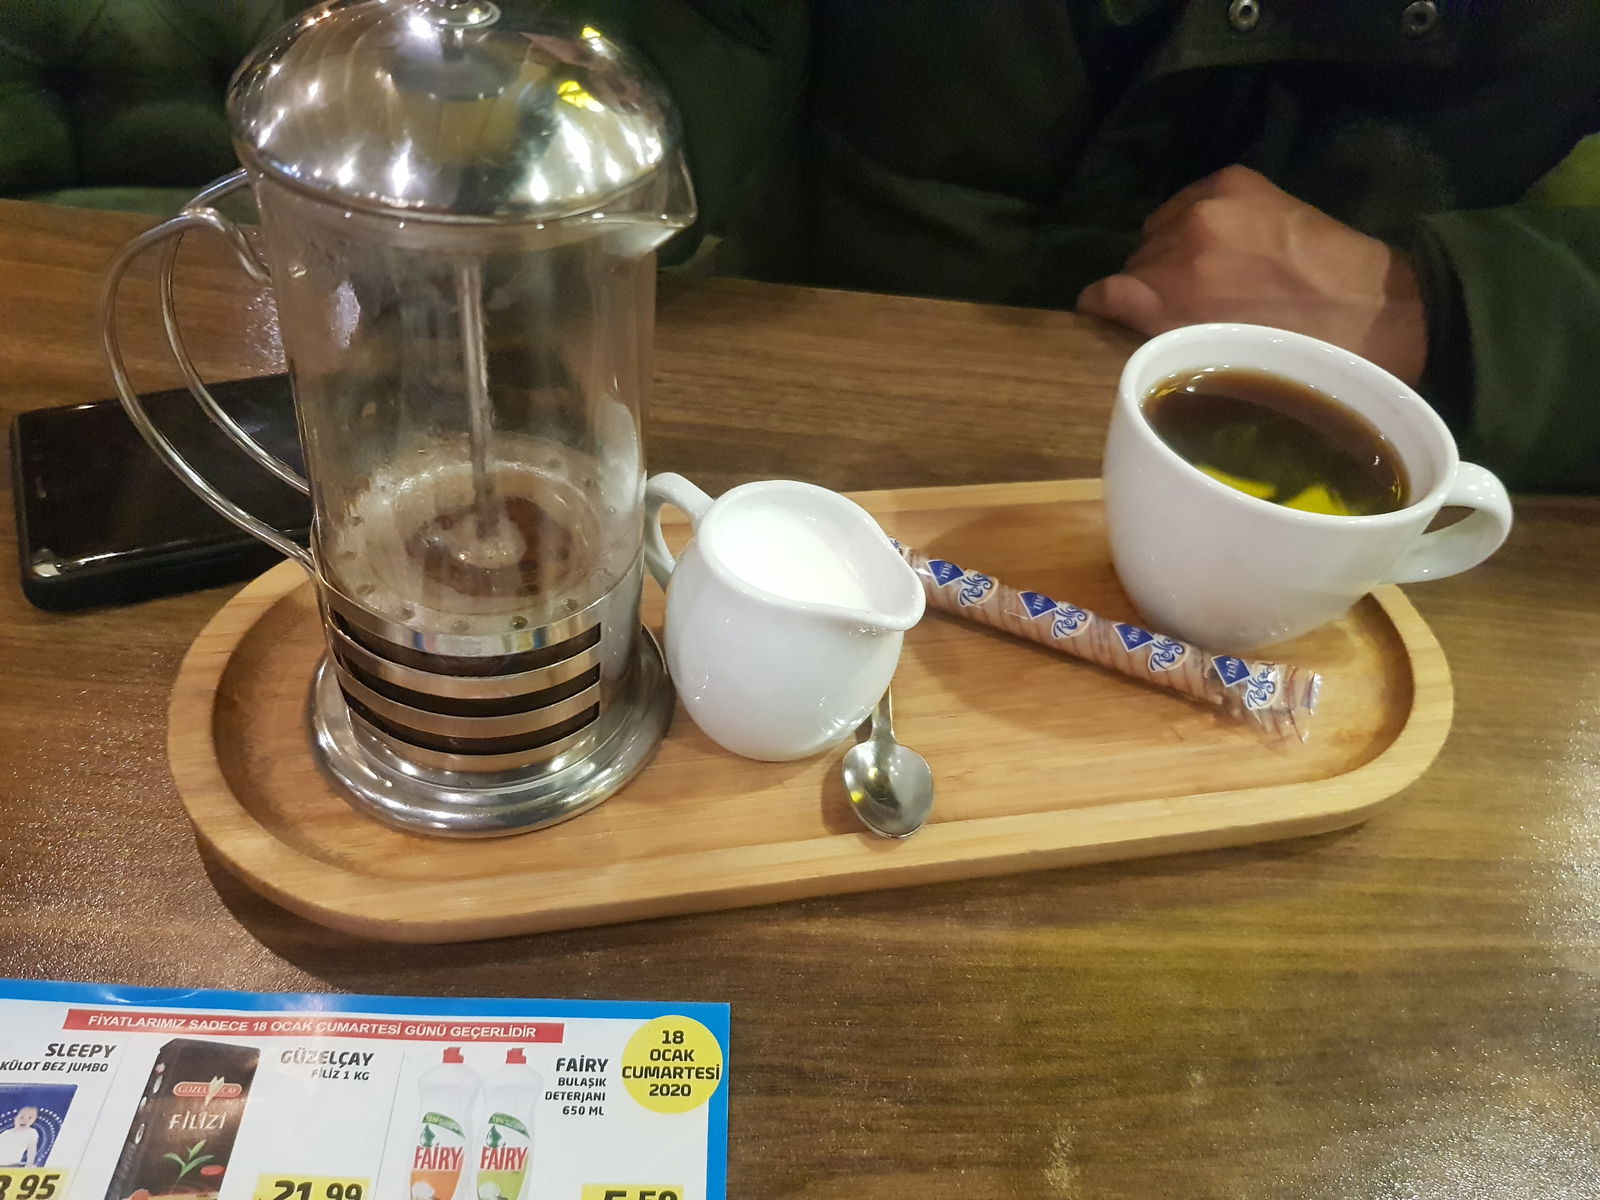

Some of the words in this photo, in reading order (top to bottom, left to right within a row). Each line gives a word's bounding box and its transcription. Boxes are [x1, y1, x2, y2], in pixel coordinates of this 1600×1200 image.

[88, 1015, 185, 1029] FİYATLARIMIZ
[189, 1019, 247, 1031] SADECE
[252, 1021, 267, 1031] 18
[272, 1022, 311, 1032] OCAK
[316, 1022, 402, 1036] CUMARTESİ
[405, 1024, 446, 1037] GÜNÜ
[451, 1024, 537, 1039] GEÇERLİDİR
[662, 1030, 684, 1044] 18
[45, 1043, 116, 1058] SLEEPY
[650, 1049, 694, 1062] OCAK
[281, 1048, 374, 1067] GÜZELÇAY
[556, 1055, 608, 1072] FAİRY
[0, 1060, 40, 1072] KÜLOT
[43, 1061, 65, 1071] BEZ
[65, 1062, 108, 1073] JUMBO
[622, 1064, 720, 1080] CUMARTESİ
[311, 1068, 340, 1080] FİLİZ
[344, 1070, 350, 1079] 1
[354, 1072, 370, 1080] KG
[558, 1077, 606, 1089] BULAŞIK
[545, 1091, 606, 1102] DETERJANI
[649, 1084, 691, 1097] 2020
[563, 1106, 585, 1115] 650
[588, 1107, 604, 1115] ML
